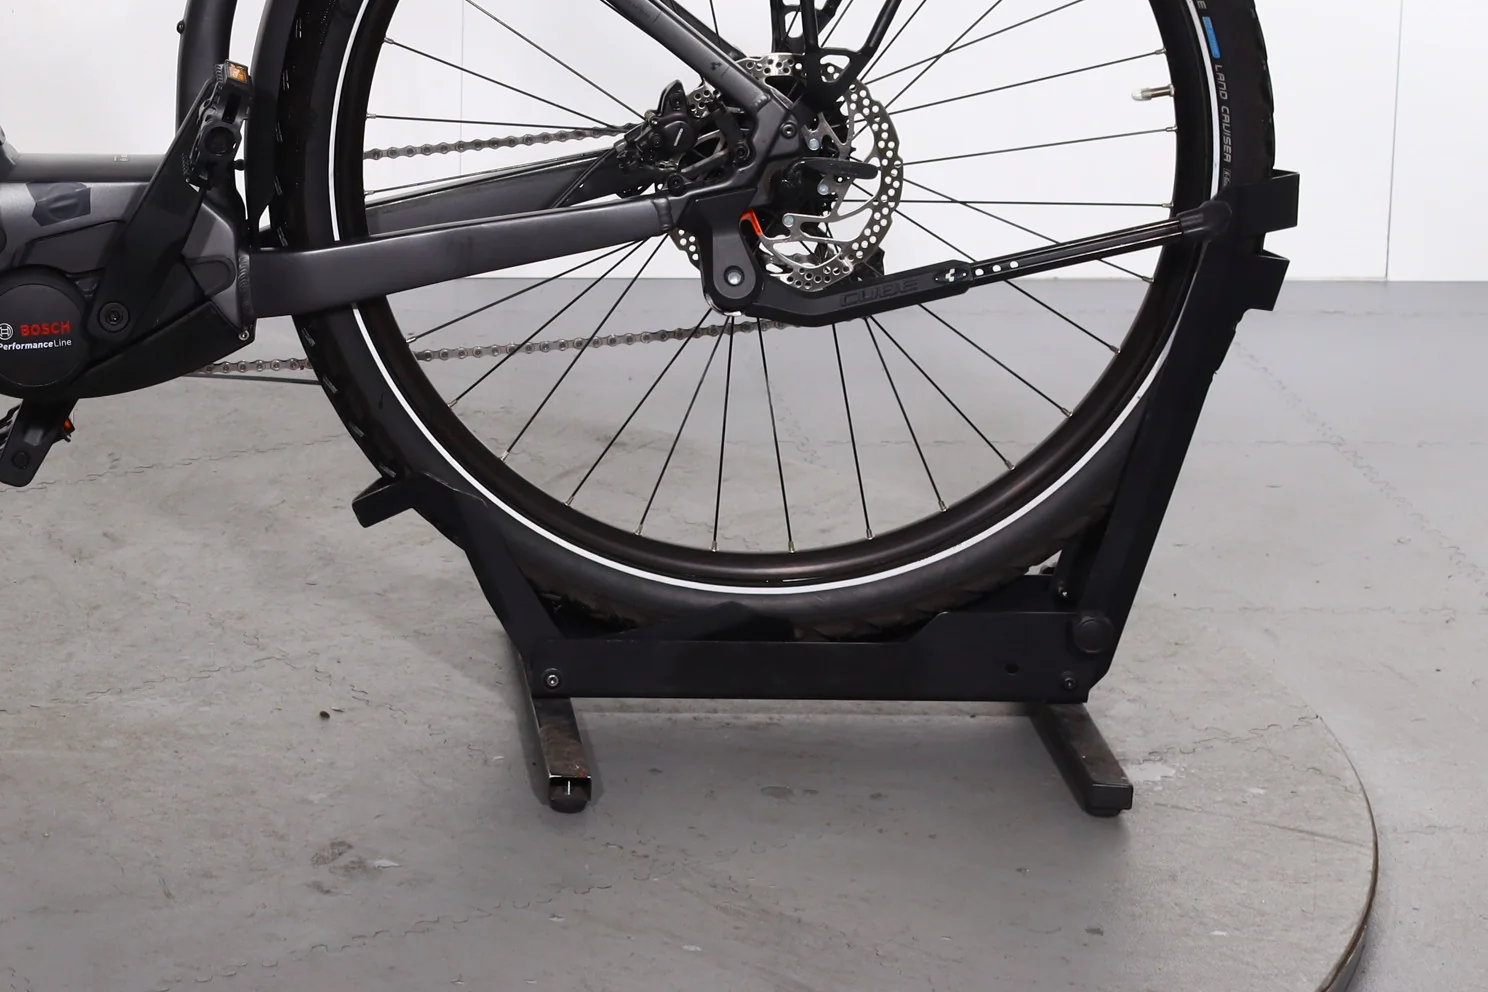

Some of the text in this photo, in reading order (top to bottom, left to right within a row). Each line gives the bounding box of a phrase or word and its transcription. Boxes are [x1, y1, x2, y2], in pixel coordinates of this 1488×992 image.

[1214, 64, 1229, 100] LAND
[1220, 104, 1233, 163] CRUISER
[840, 280, 919, 306] CUBE
[20, 321, 71, 337] BOSCH
